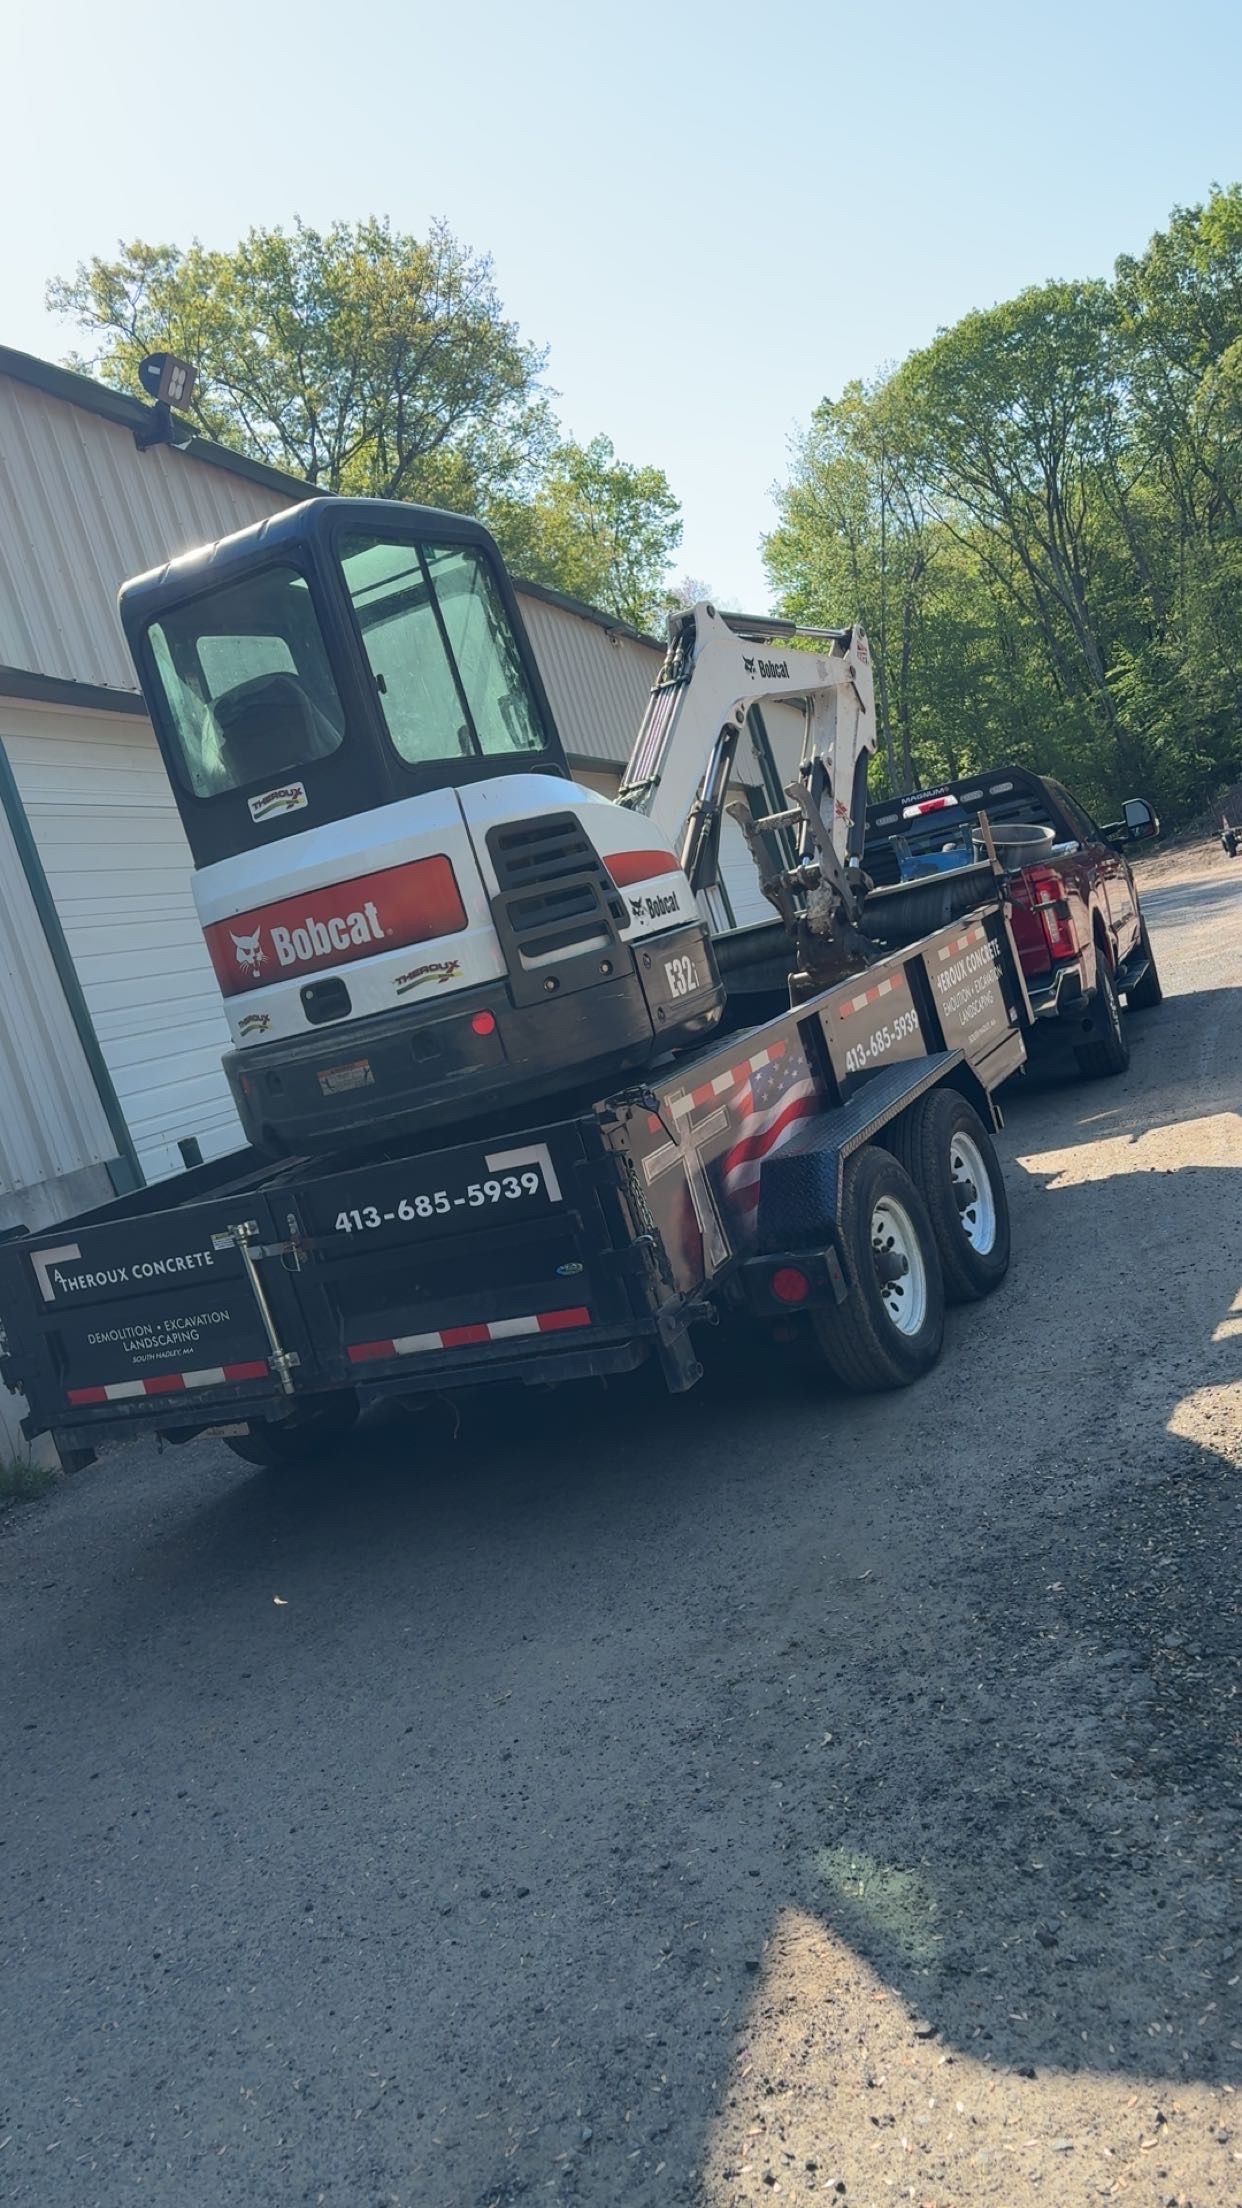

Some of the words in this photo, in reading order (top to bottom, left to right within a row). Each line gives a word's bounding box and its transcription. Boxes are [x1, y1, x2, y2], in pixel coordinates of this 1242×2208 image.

[757, 659, 790, 679] Bobcat
[252, 787, 303, 810] THEROUX
[901, 787, 945, 805] MAGNUM
[645, 890, 680, 919] Bobcat
[270, 902, 385, 966] Bobcat
[966, 938, 1001, 974] CONCRETE
[394, 959, 460, 985] THEROUX
[664, 955, 700, 998] E32i
[845, 1009, 920, 1072] 413-685-5939
[335, 1172, 539, 1233] 413-685-5939
[131, 1251, 214, 1279] CONCRETE
[87, 1324, 153, 1345] DEMOLITION
[163, 1310, 230, 1332] EXCAVATION
[122, 1329, 200, 1352] LANDSCAPING
[132, 1353, 155, 1363] SOUTH
